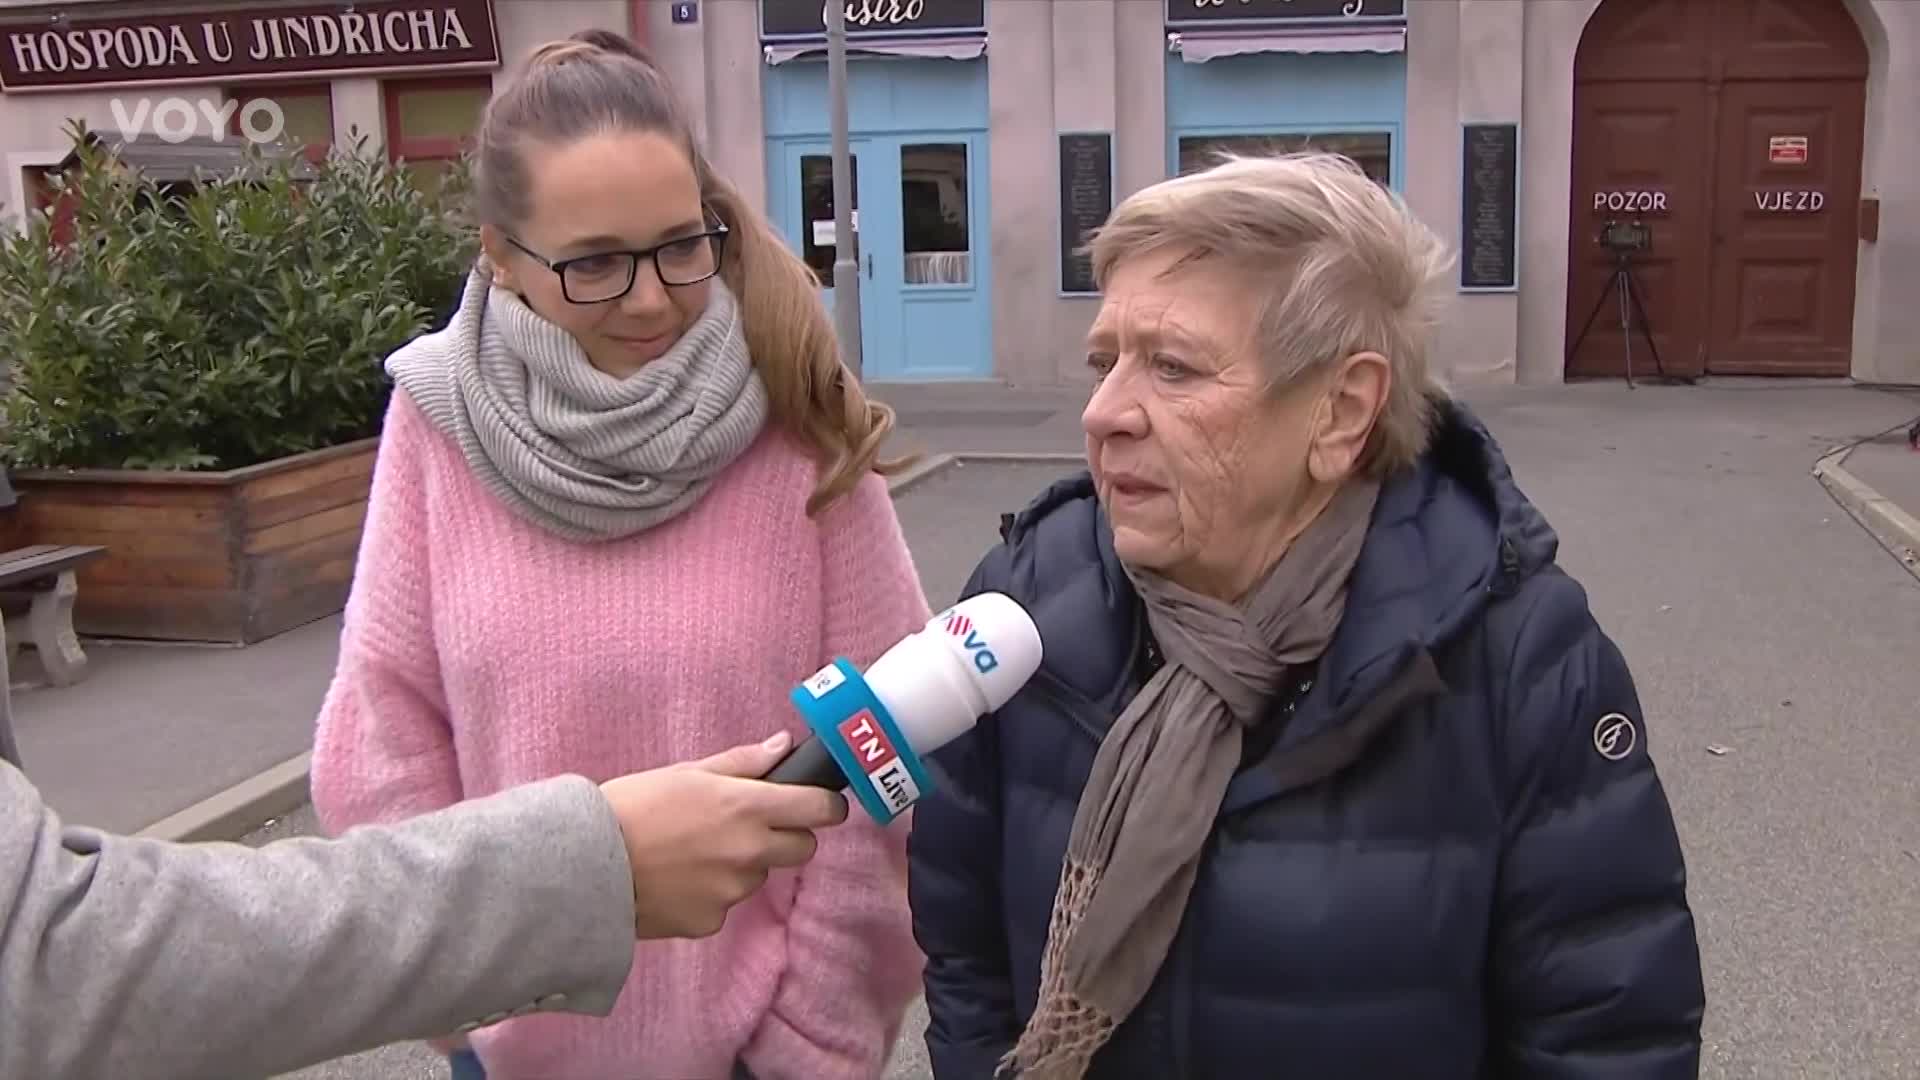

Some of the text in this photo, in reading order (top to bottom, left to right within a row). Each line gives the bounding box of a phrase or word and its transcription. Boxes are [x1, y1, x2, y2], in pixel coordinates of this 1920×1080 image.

[9, 25, 200, 73] HOSPODA
[201, 21, 234, 63] U
[1593, 191, 1825, 211] POZOR VJEZD
[850, 717, 910, 808] TN Live
